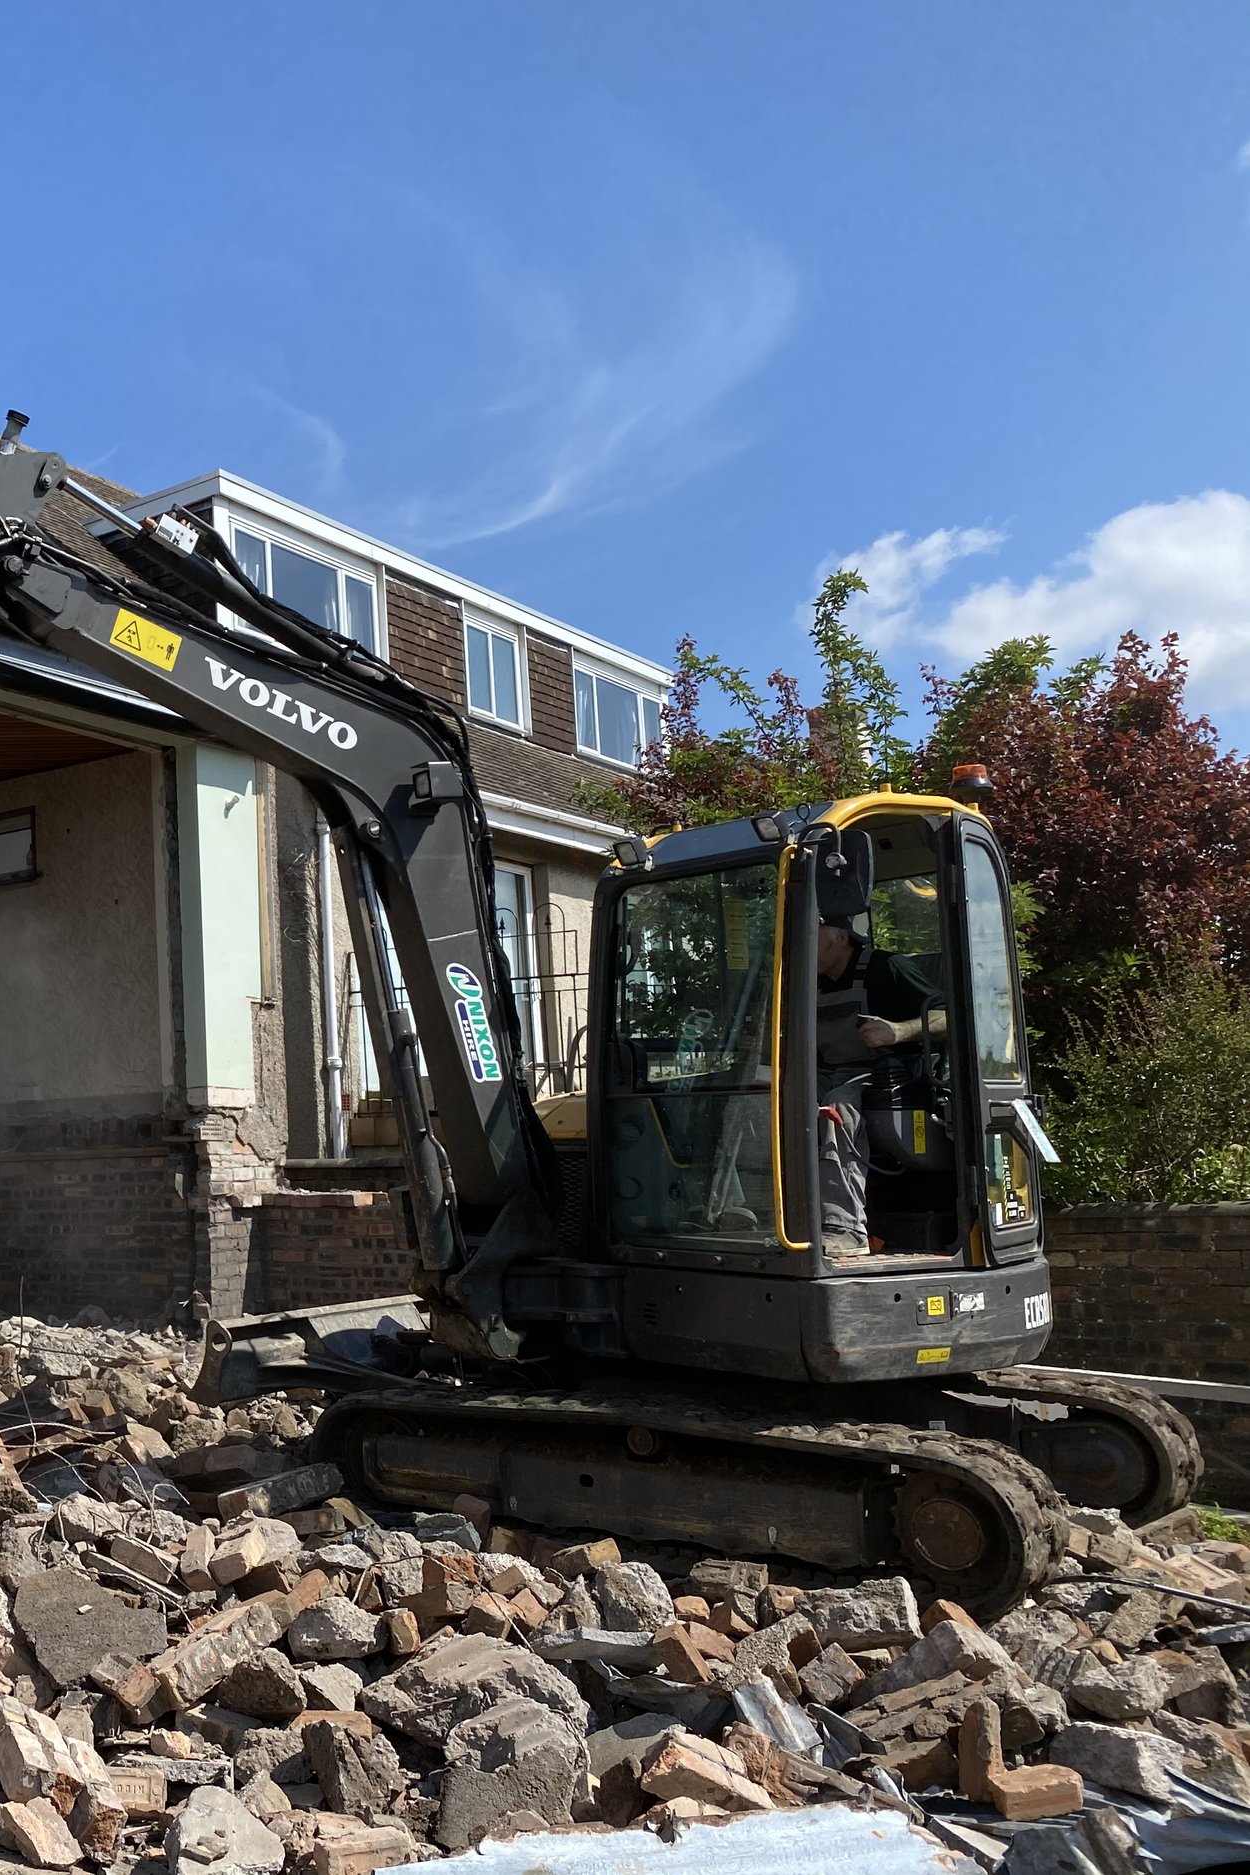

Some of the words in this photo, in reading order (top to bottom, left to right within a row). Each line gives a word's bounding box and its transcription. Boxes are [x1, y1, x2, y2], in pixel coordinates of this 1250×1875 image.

[204, 655, 358, 750] VOLVO
[462, 1019, 478, 1061] HIRE
[467, 1001, 500, 1078] NIXON
